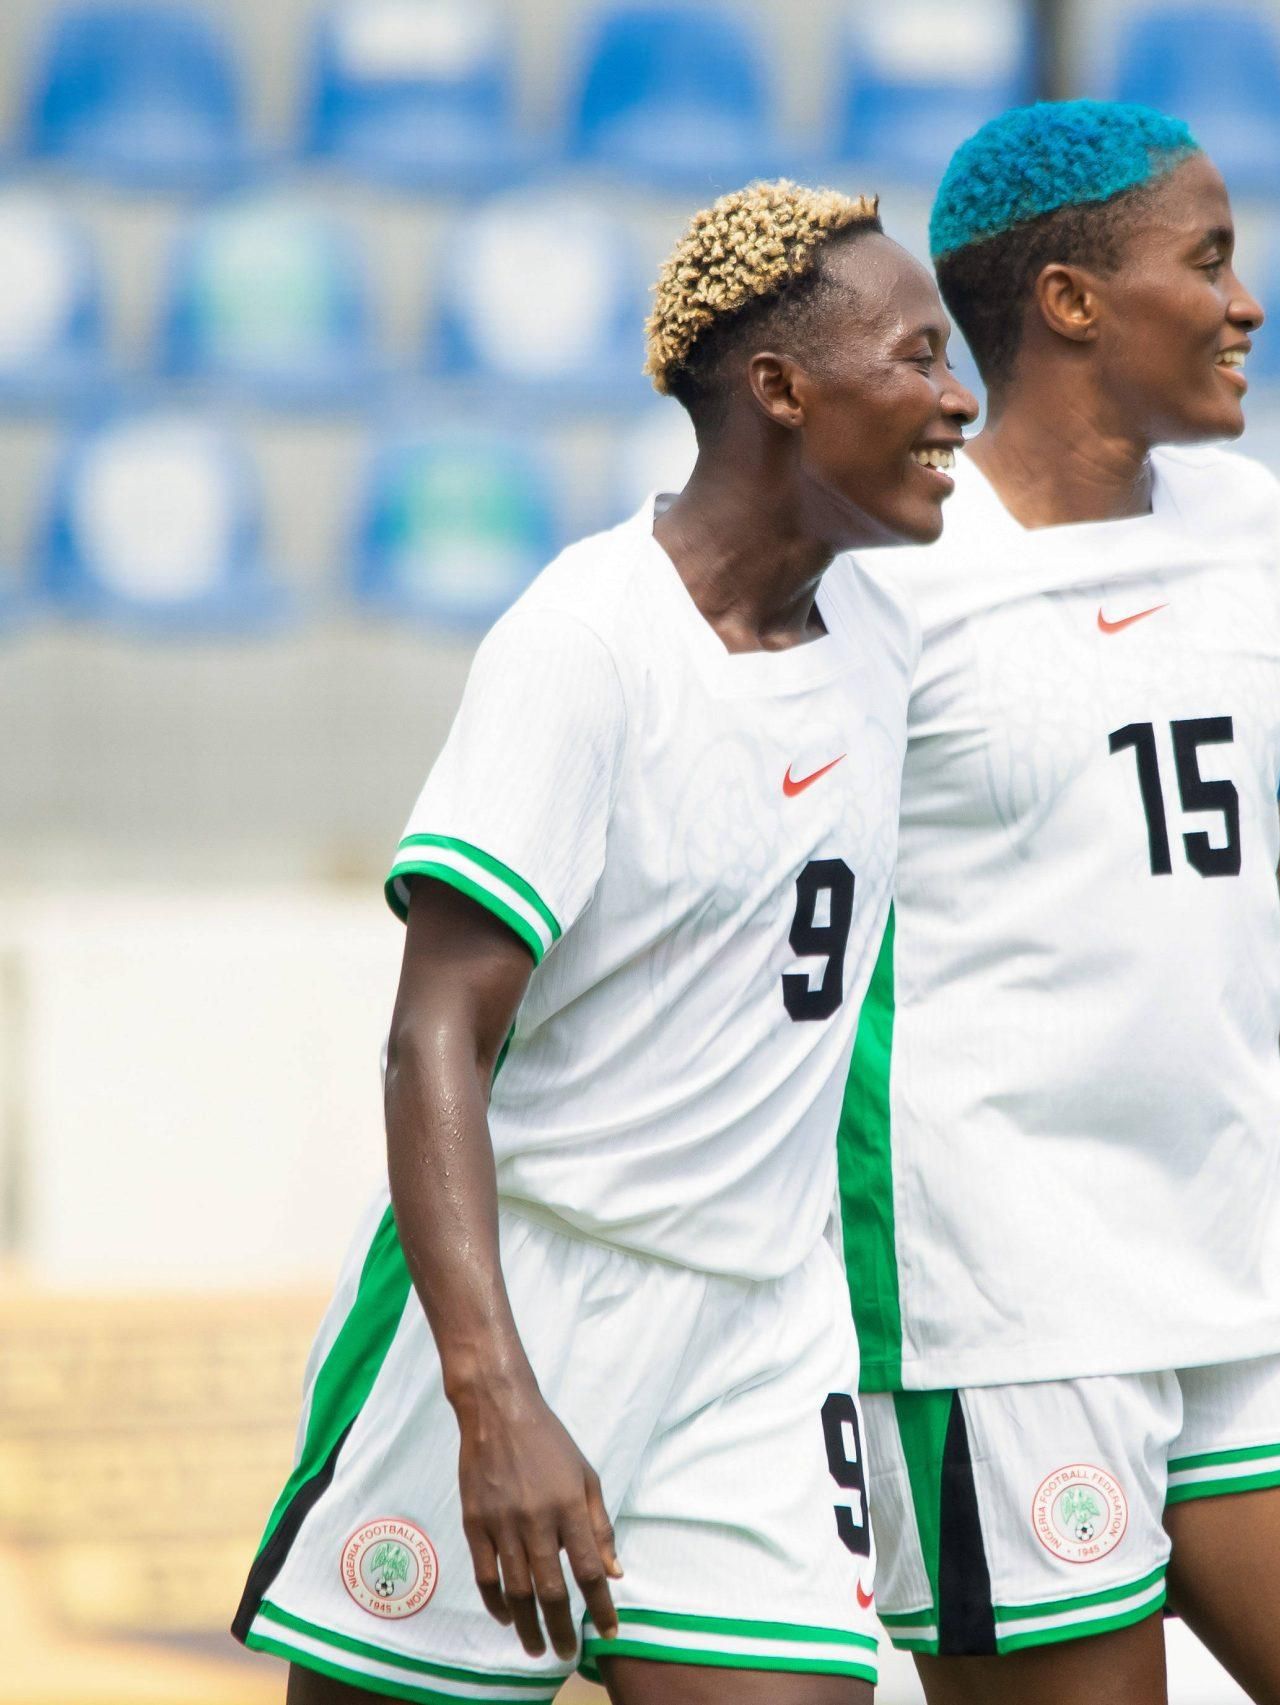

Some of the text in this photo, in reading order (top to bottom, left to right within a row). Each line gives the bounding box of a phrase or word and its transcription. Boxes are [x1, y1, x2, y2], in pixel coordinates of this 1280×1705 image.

[1109, 717, 1241, 877] 15
[782, 859, 856, 1022] 9
[821, 1393, 871, 1559] 9
[1038, 1469, 1122, 1549] NIGERIA FOOTBALL FEDERATION
[346, 1525, 432, 1609] NIGERIA FOOTBALL FEDERATION
[1078, 1544, 1101, 1557] 1945
[368, 1599, 392, 1613] 1945
